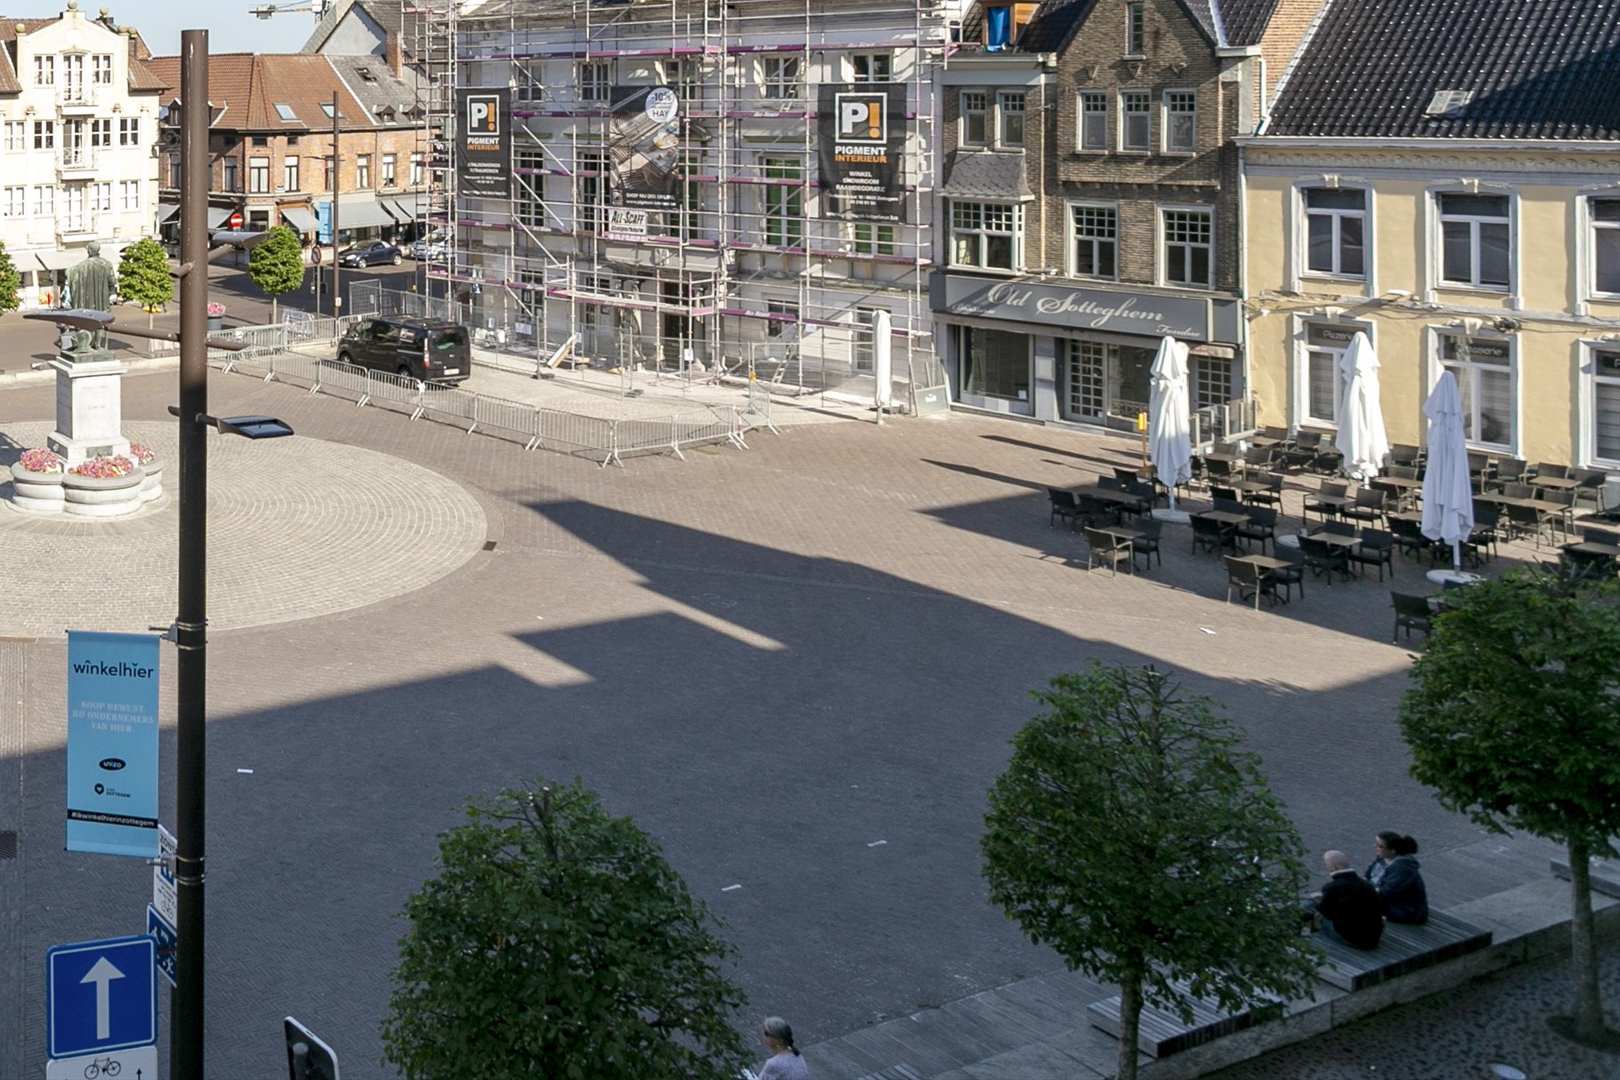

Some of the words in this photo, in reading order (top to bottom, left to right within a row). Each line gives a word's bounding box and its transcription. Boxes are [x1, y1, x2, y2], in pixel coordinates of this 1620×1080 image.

[653, 110, 670, 118] HAY
[467, 137, 500, 145] PIGMENT
[835, 146, 887, 156] PIGMENT
[835, 155, 887, 163] INTERIEUR
[987, 282, 1033, 306] Old
[1036, 291, 1164, 327] Sotteghem
[1156, 324, 1201, 337] Fondue
[81, 700, 105, 710] KOOP
[87, 711, 155, 724] ONDERNEMERS
[91, 721, 108, 731] VAN
[103, 760, 123, 769] unizo
[71, 811, 156, 827] #ikwinkelhierinzottegem
